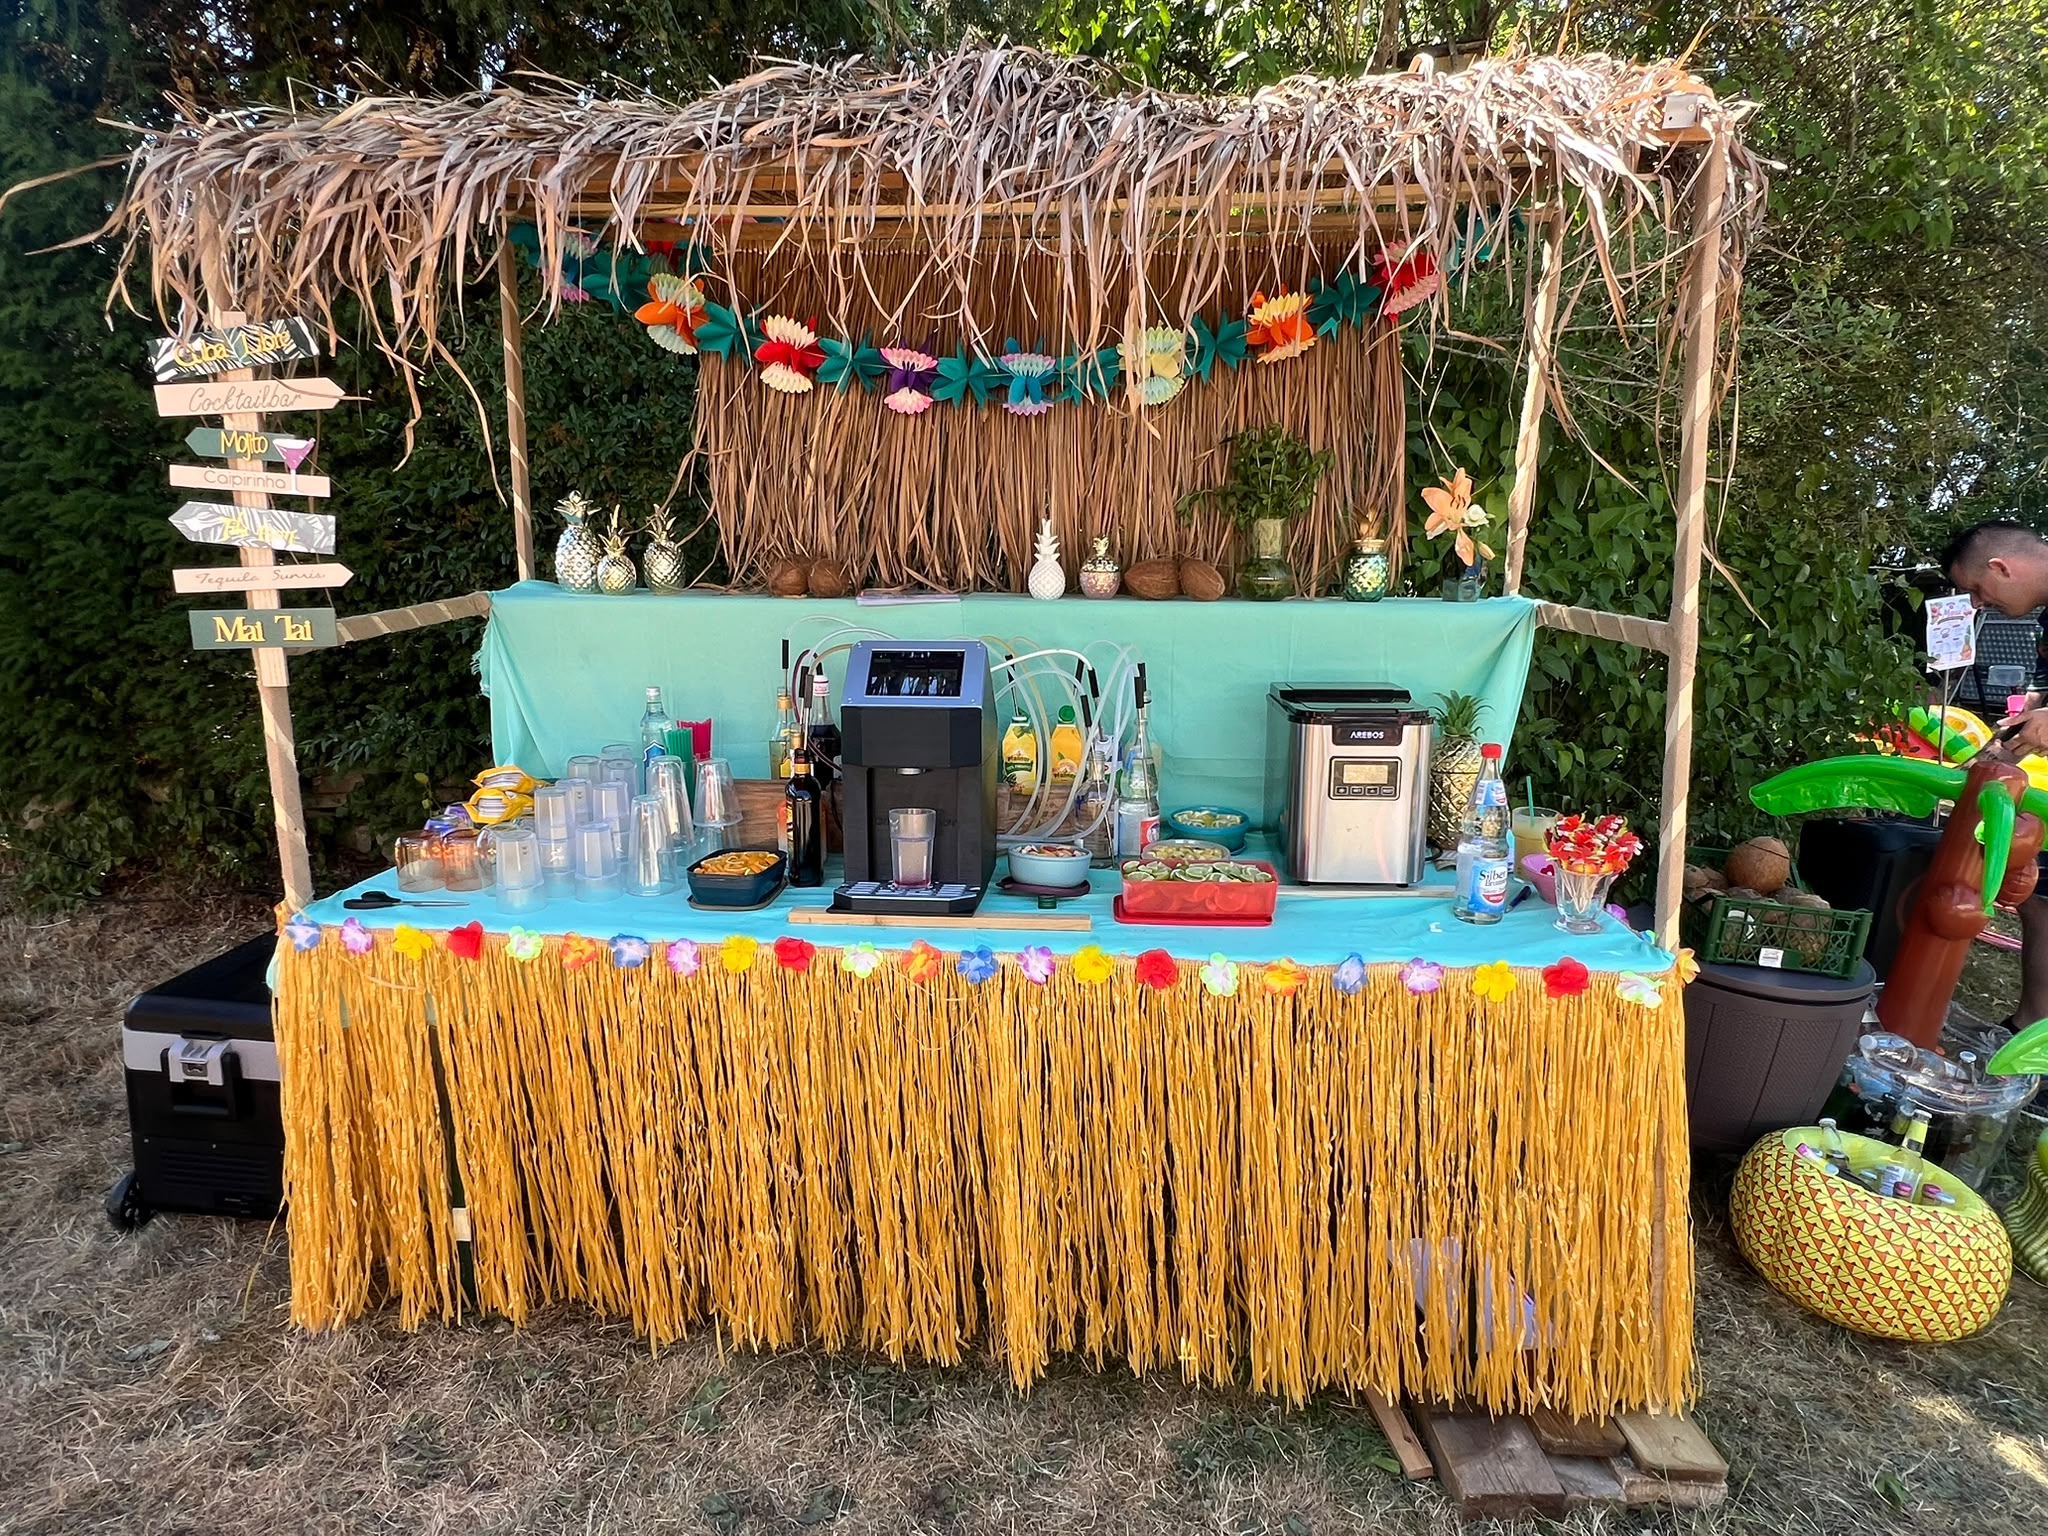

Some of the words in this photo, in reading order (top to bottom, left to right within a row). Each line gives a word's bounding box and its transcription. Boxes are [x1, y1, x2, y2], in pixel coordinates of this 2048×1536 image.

[174, 339, 227, 368] Cuba
[239, 329, 292, 355] Libre
[188, 384, 303, 413] Cocktailbar
[220, 430, 269, 461] Mojito
[203, 469, 287, 489] Caipirinha
[195, 571, 259, 590] Tequila
[213, 616, 266, 643] Mai
[274, 614, 314, 641] Tai
[1350, 731, 1385, 739] AREBOS
[1479, 869, 1506, 881] Silber
